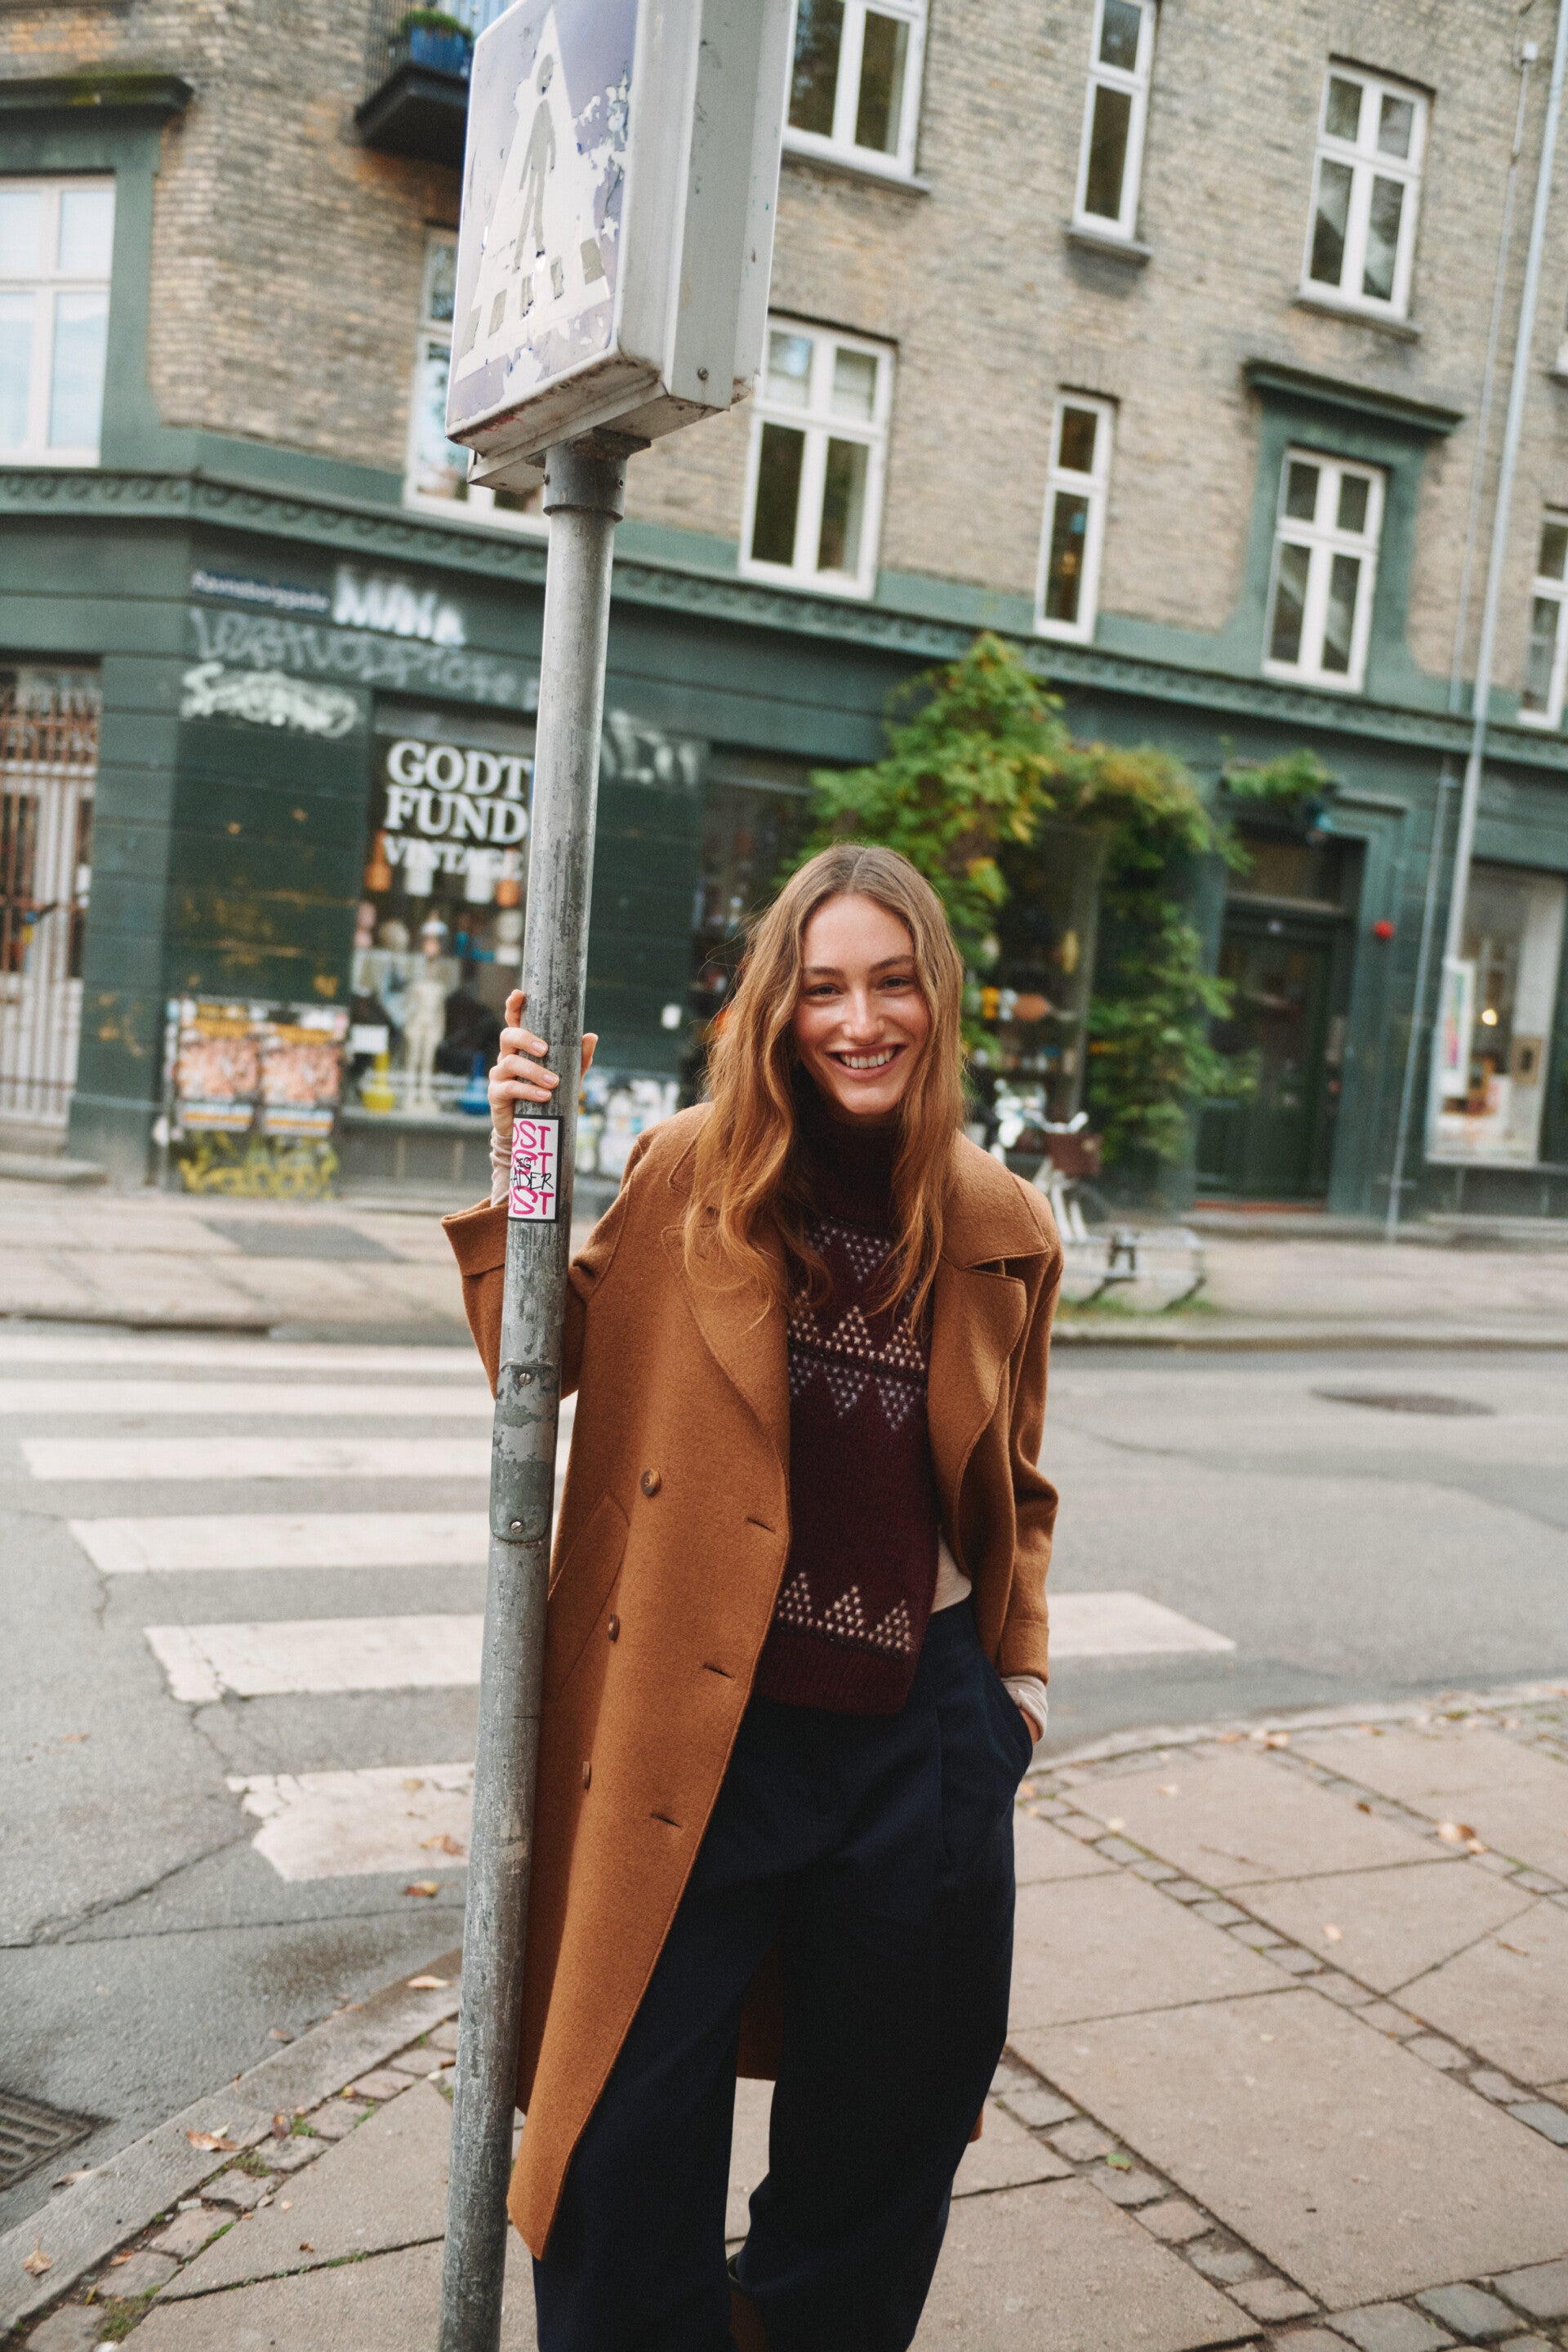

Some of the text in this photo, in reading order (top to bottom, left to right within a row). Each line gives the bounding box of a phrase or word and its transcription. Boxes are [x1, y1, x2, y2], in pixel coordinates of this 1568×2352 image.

[387, 740, 534, 800] GODT
[383, 785, 529, 844] FUND
[511, 1150, 554, 1175] ST
[509, 1186, 555, 1215] ST
